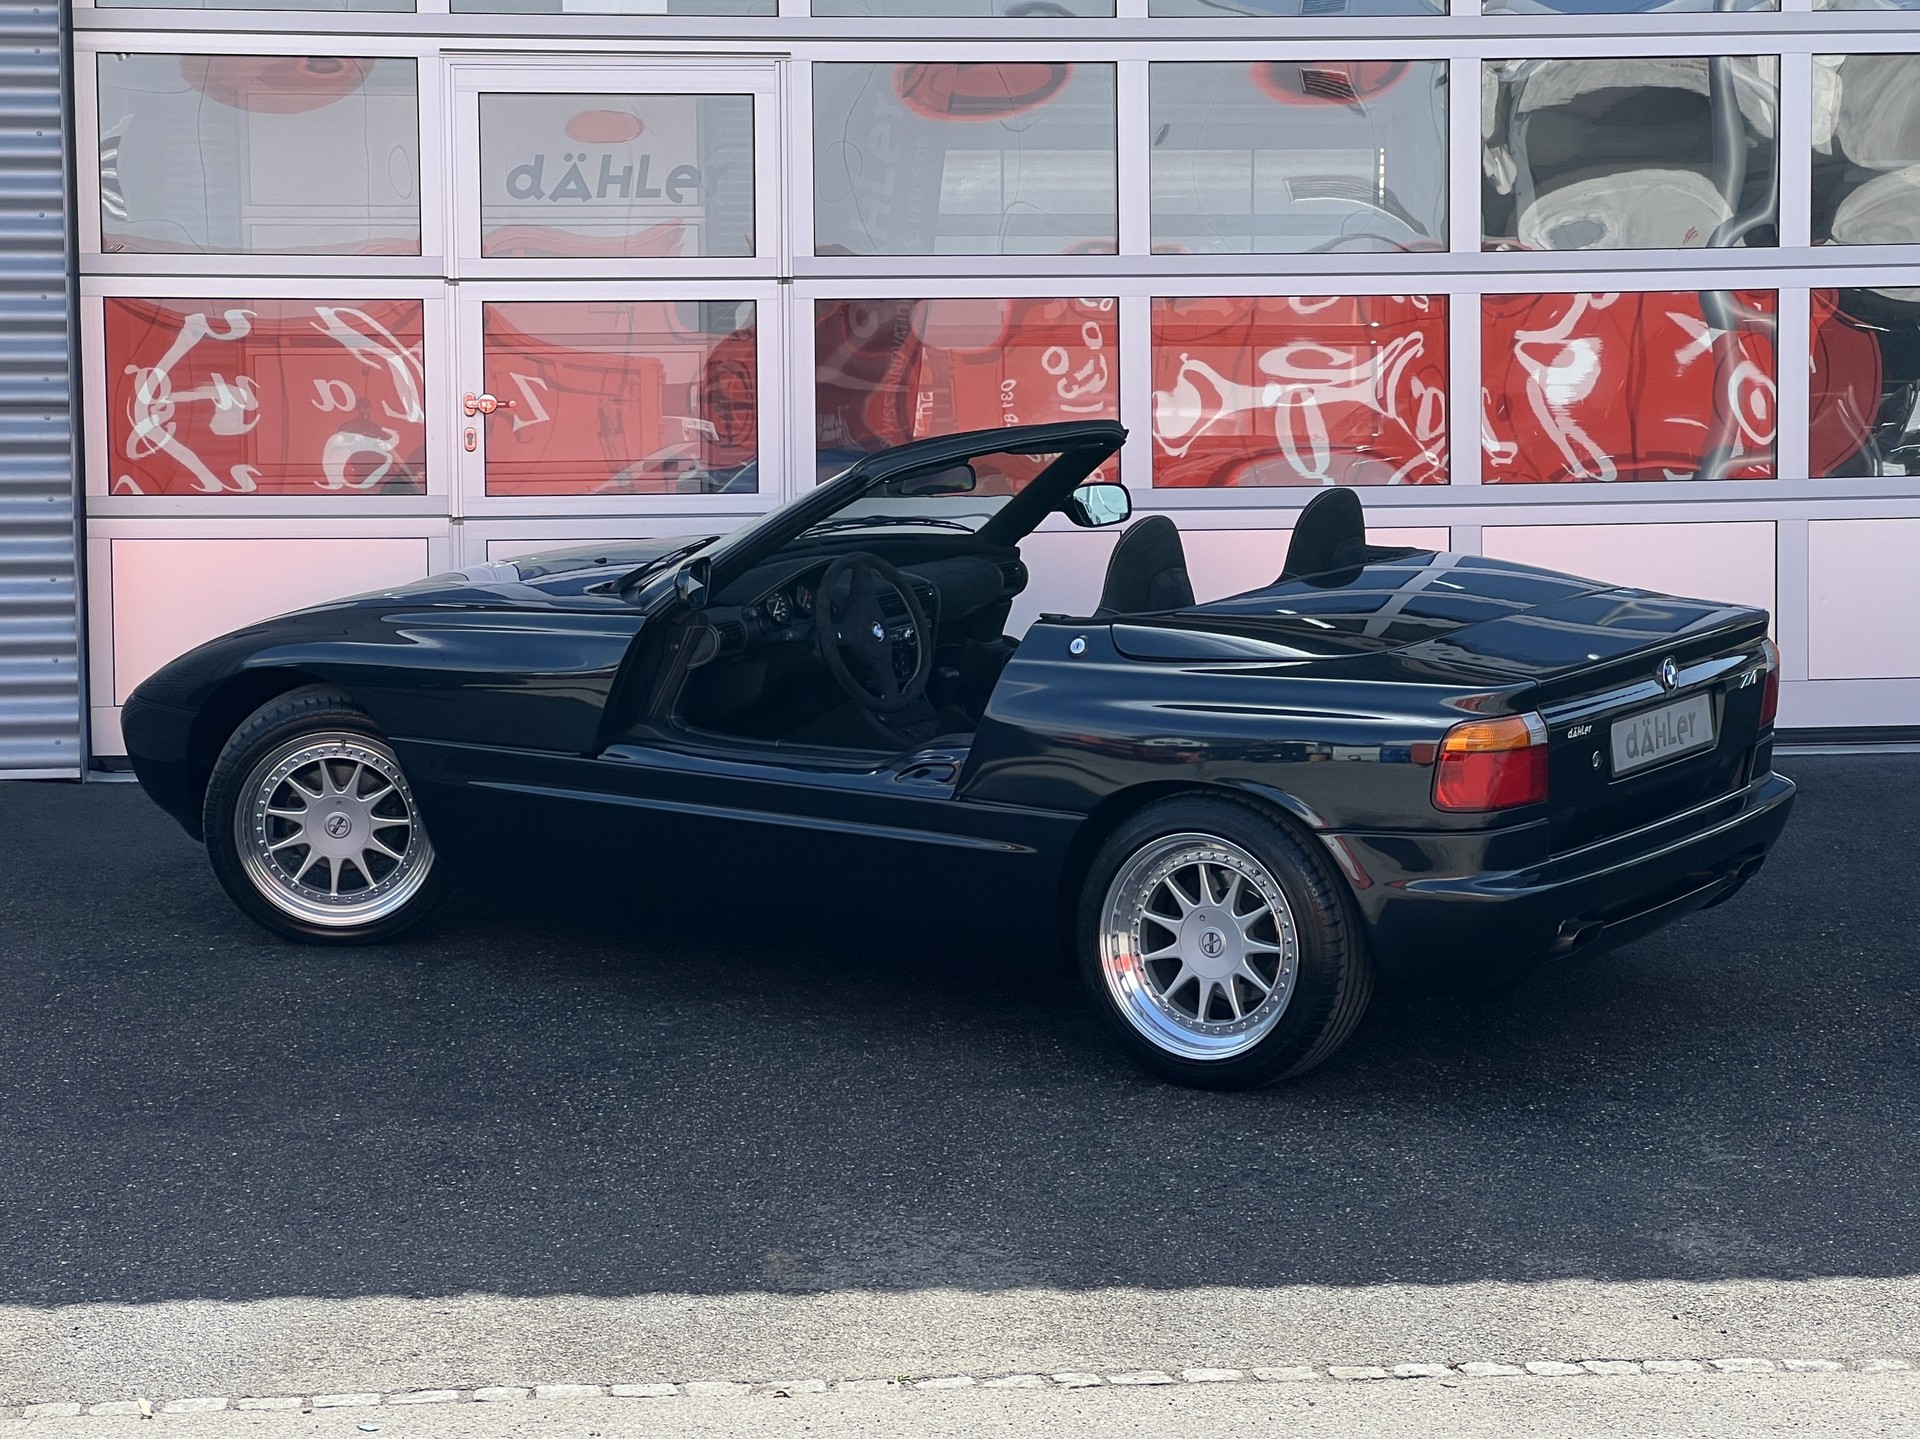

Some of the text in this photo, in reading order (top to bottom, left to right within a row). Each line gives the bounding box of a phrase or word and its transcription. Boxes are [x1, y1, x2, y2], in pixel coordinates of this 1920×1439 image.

[506, 152, 729, 204] dÄHLer
[884, 302, 909, 393] INNOVATIO
[1626, 711, 1697, 760] dÄHLer
